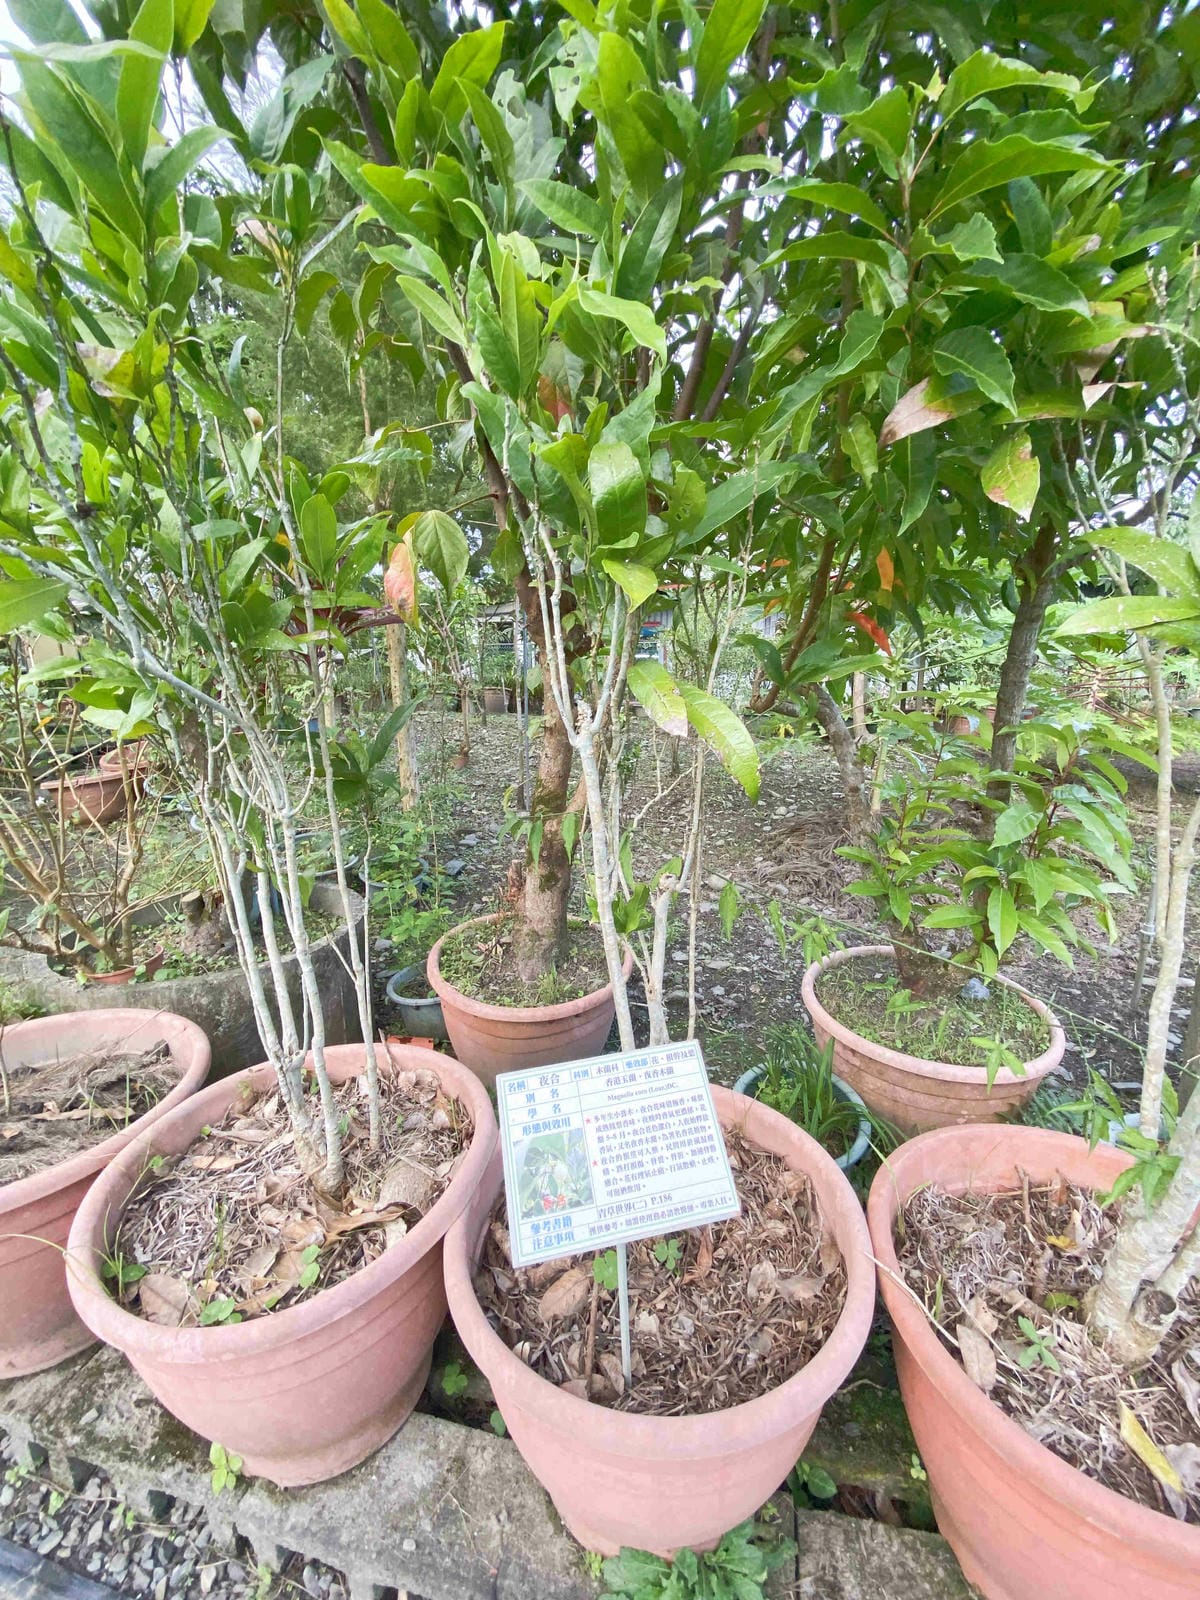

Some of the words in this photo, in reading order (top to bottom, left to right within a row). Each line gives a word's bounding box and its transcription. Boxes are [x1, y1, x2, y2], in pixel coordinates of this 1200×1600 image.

[572, 1069, 589, 1080] 科別
[595, 1063, 618, 1075] 木蘭科
[507, 1079, 525, 1092] 名稱
[538, 1072, 560, 1086] 夜合
[607, 1090, 633, 1102] Magnolia
[521, 1116, 570, 1135] 形態與效用
[650, 1192, 672, 1205] P.186
[530, 1214, 572, 1235] 參考書籍
[532, 1229, 574, 1251] 注意事項
